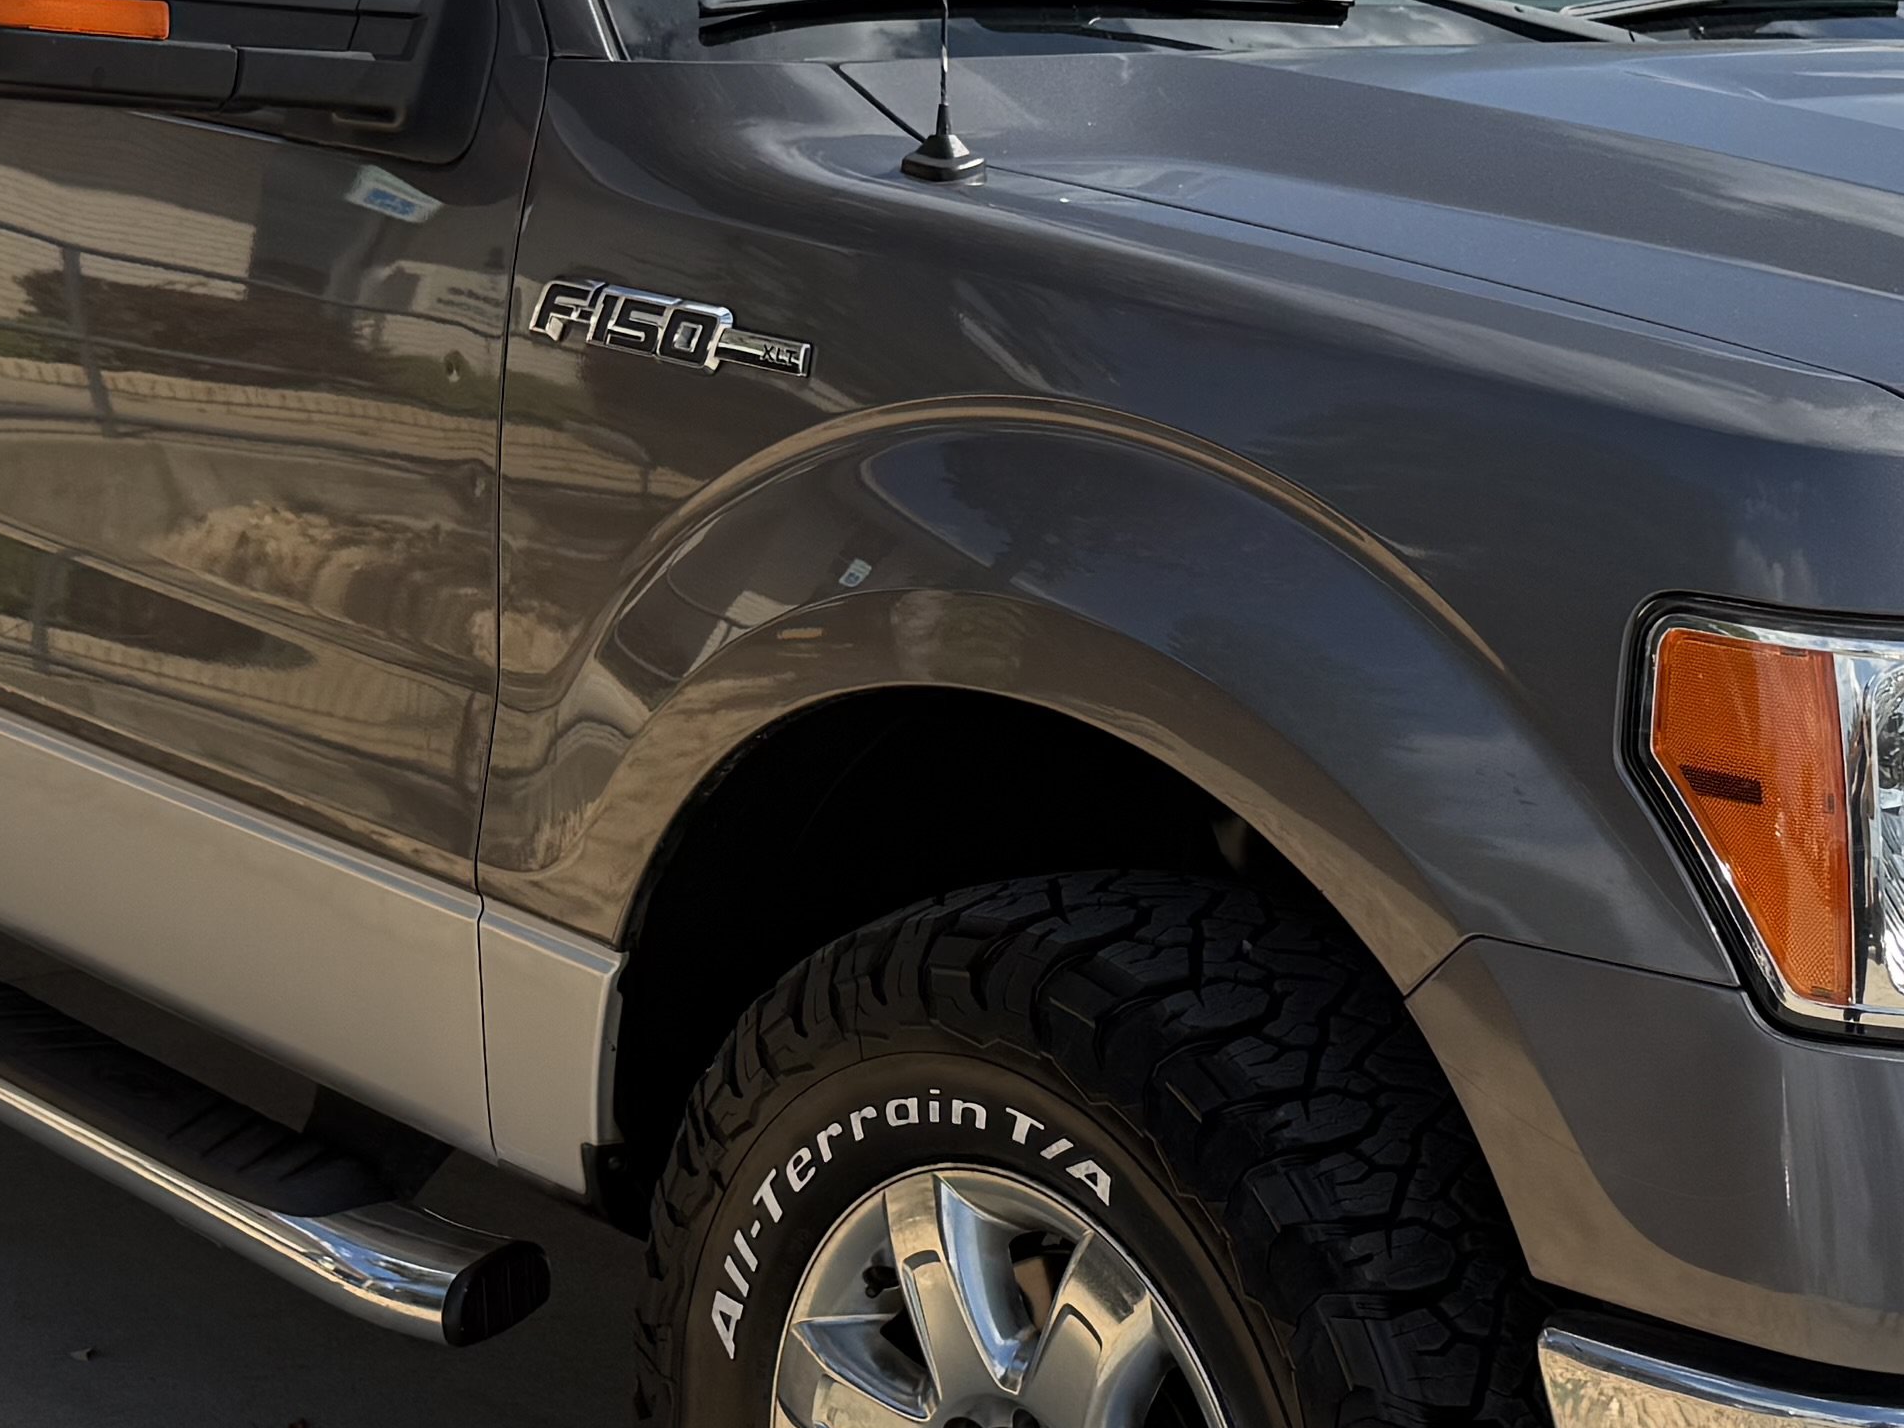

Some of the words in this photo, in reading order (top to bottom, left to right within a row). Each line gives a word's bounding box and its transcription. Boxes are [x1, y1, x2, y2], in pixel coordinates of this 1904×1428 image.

[761, 343, 801, 367] XLT
[711, 1089, 987, 1360] All-Terrain
[1005, 1106, 1111, 1207] T/A
